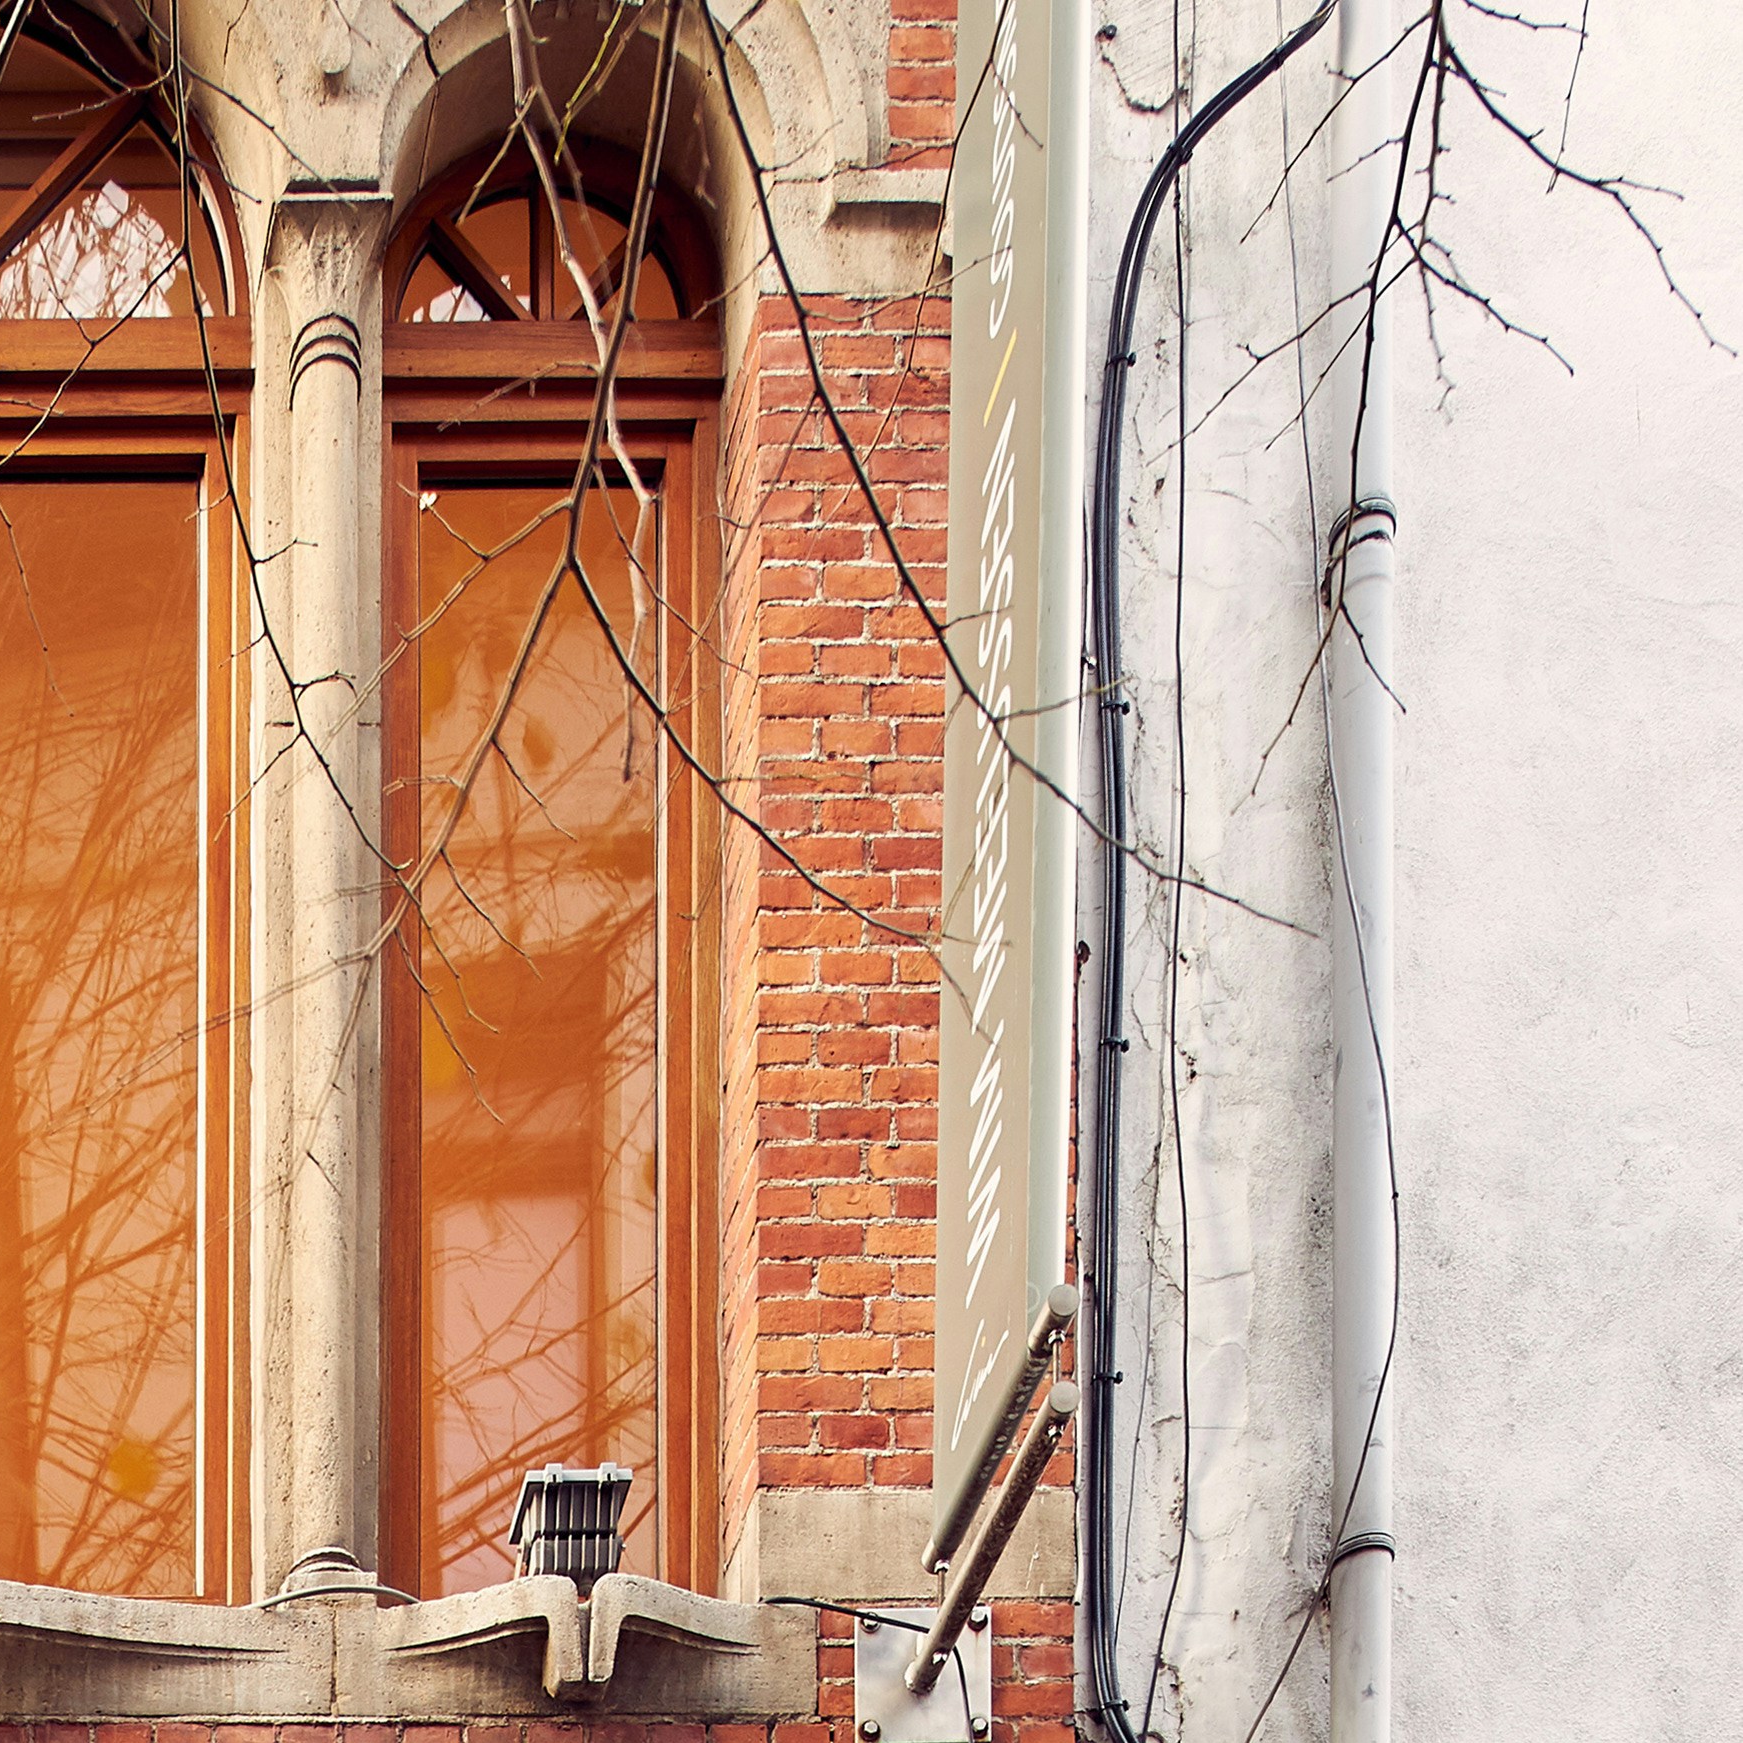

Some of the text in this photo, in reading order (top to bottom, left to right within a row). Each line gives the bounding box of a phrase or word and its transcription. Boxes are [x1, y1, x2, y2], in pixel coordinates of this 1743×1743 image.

[965, 0, 1018, 1310] WIM MEEUSSEN GOUDSM
